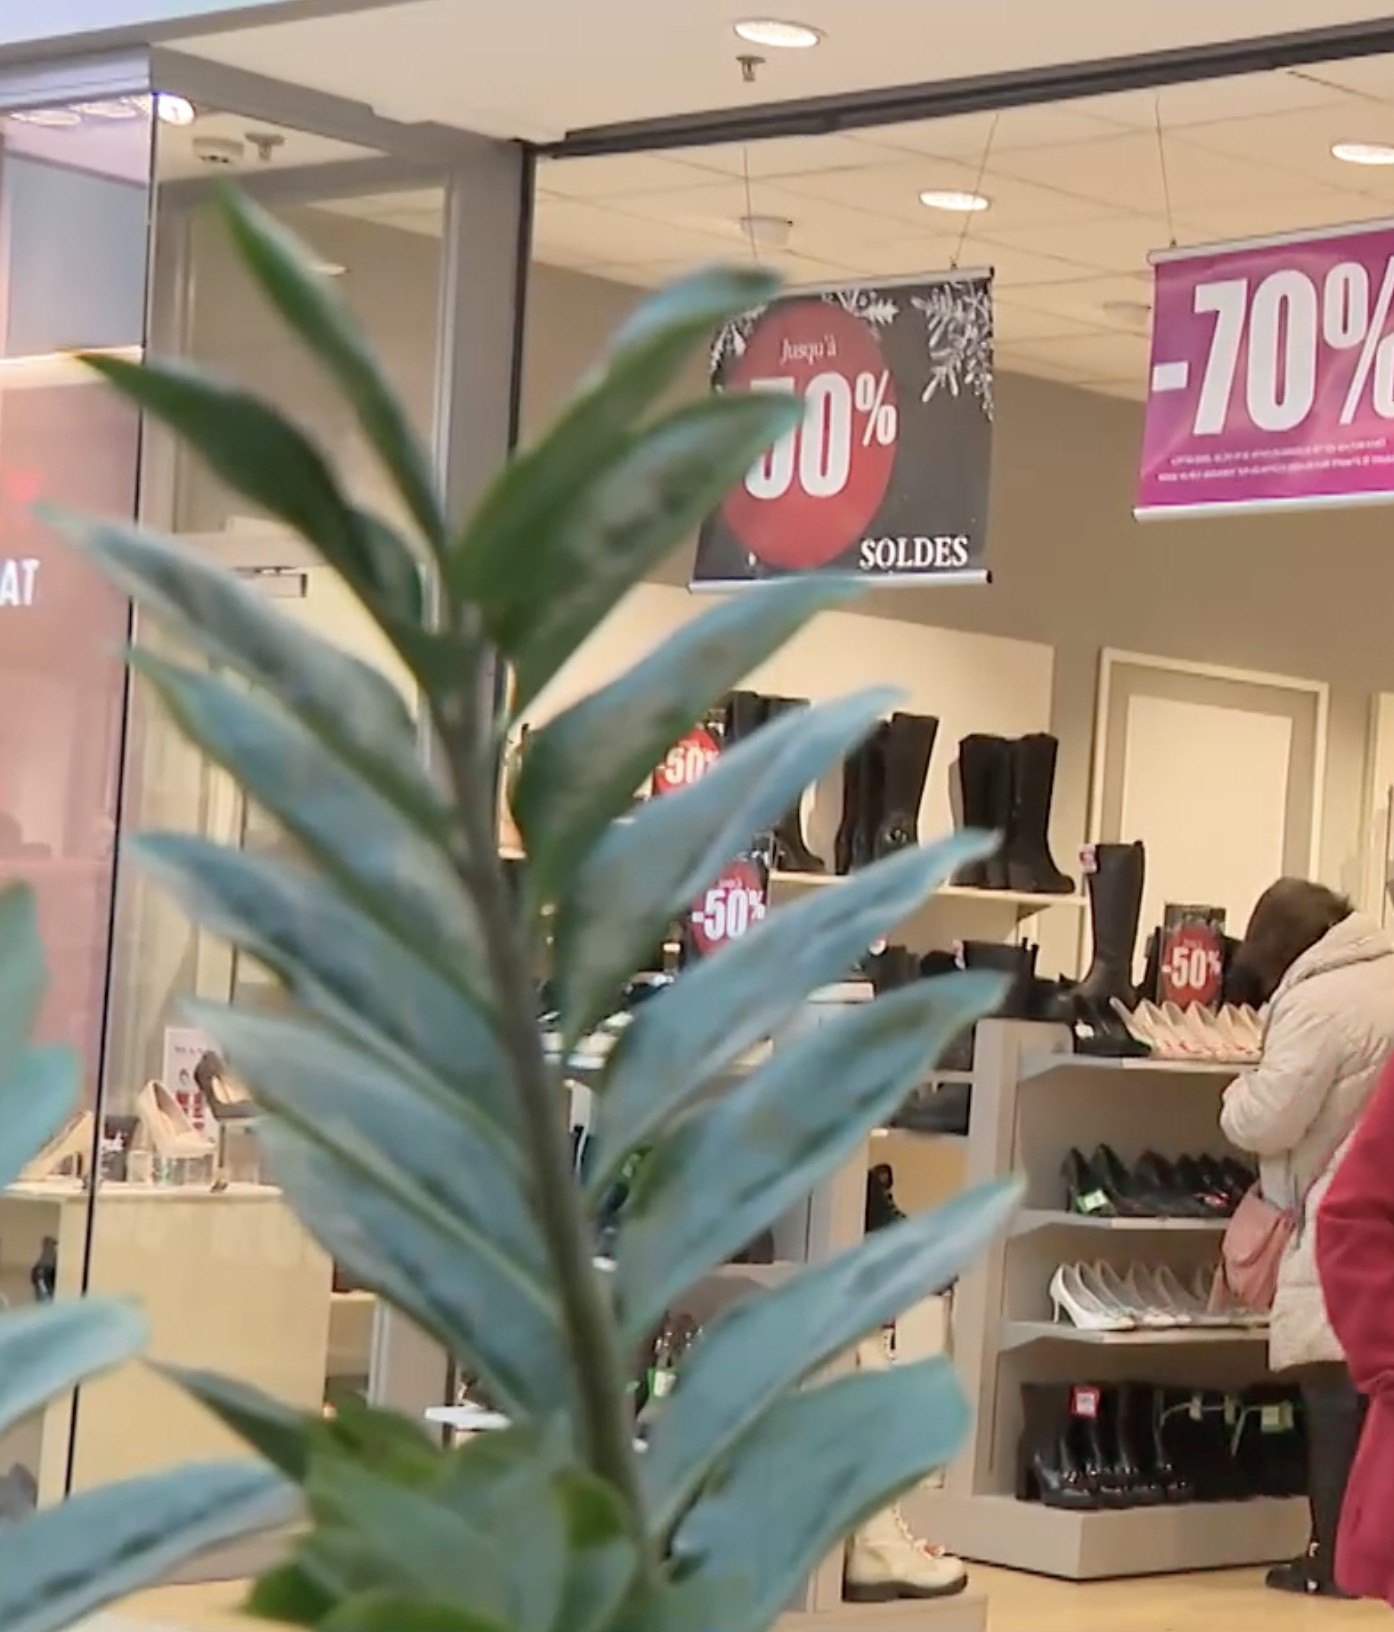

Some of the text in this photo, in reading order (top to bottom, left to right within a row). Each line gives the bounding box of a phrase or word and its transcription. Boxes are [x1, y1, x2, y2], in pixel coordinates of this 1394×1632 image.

[859, 536, 969, 569] SOLDES
[692, 888, 766, 940] -50%
[1160, 946, 1221, 989] -50%
